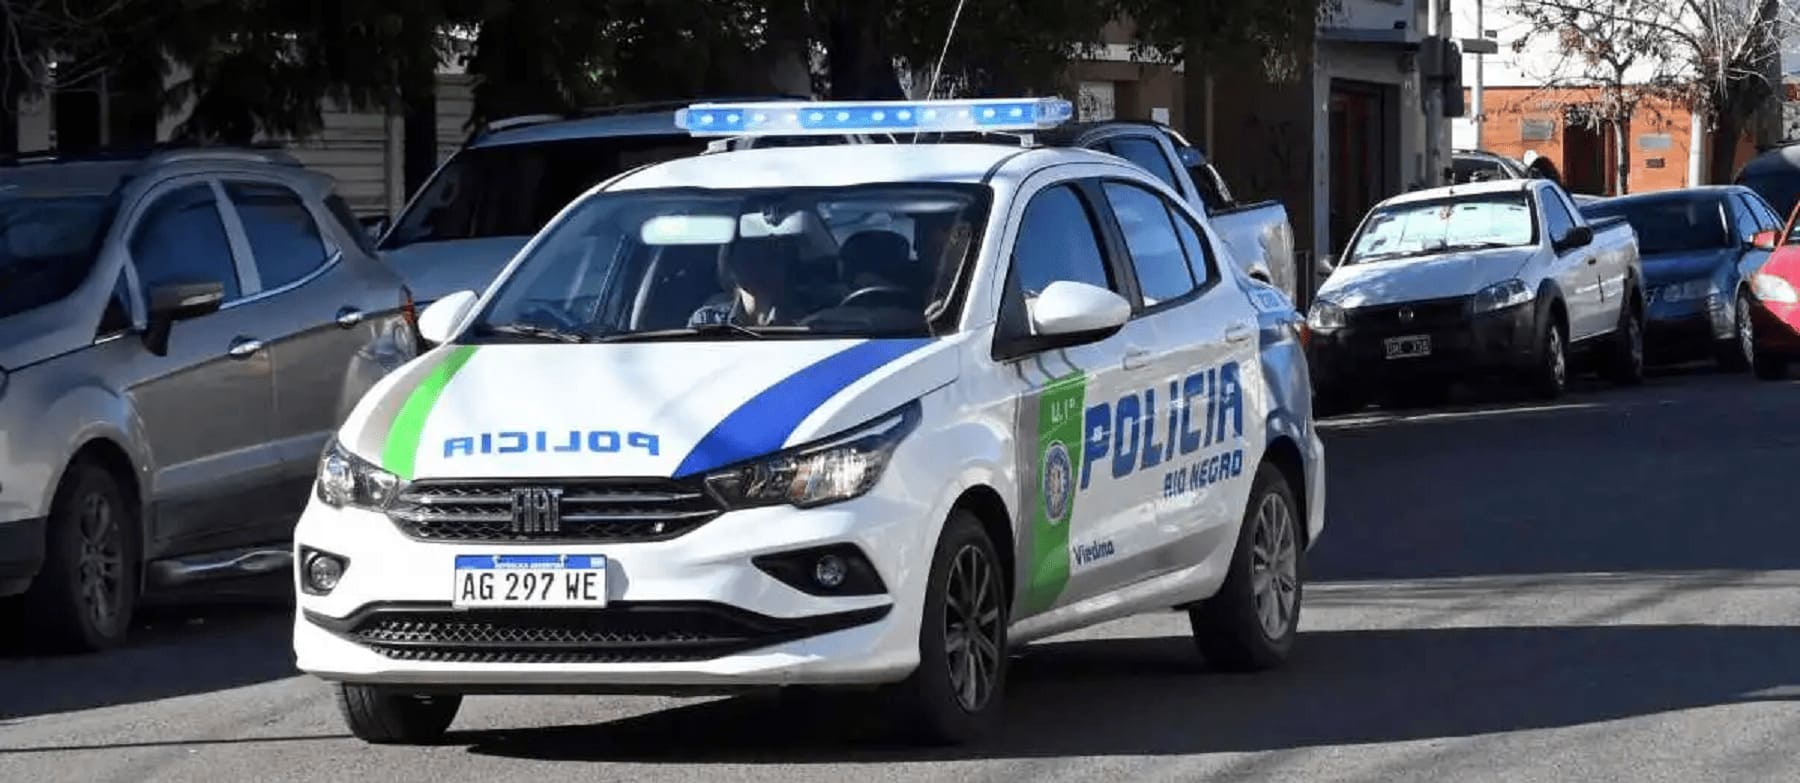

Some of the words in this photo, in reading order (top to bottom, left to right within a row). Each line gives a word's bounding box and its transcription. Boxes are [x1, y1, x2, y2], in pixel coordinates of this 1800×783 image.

[1080, 361, 1243, 490] POLICIA
[1164, 467, 1187, 498] RIO
[1189, 449, 1243, 492] NEGRO
[511, 488, 563, 532] FIAT
[1072, 540, 1115, 565] Viedma
[462, 573, 494, 600] AG
[505, 573, 555, 600] 297
[566, 573, 598, 600] WE
